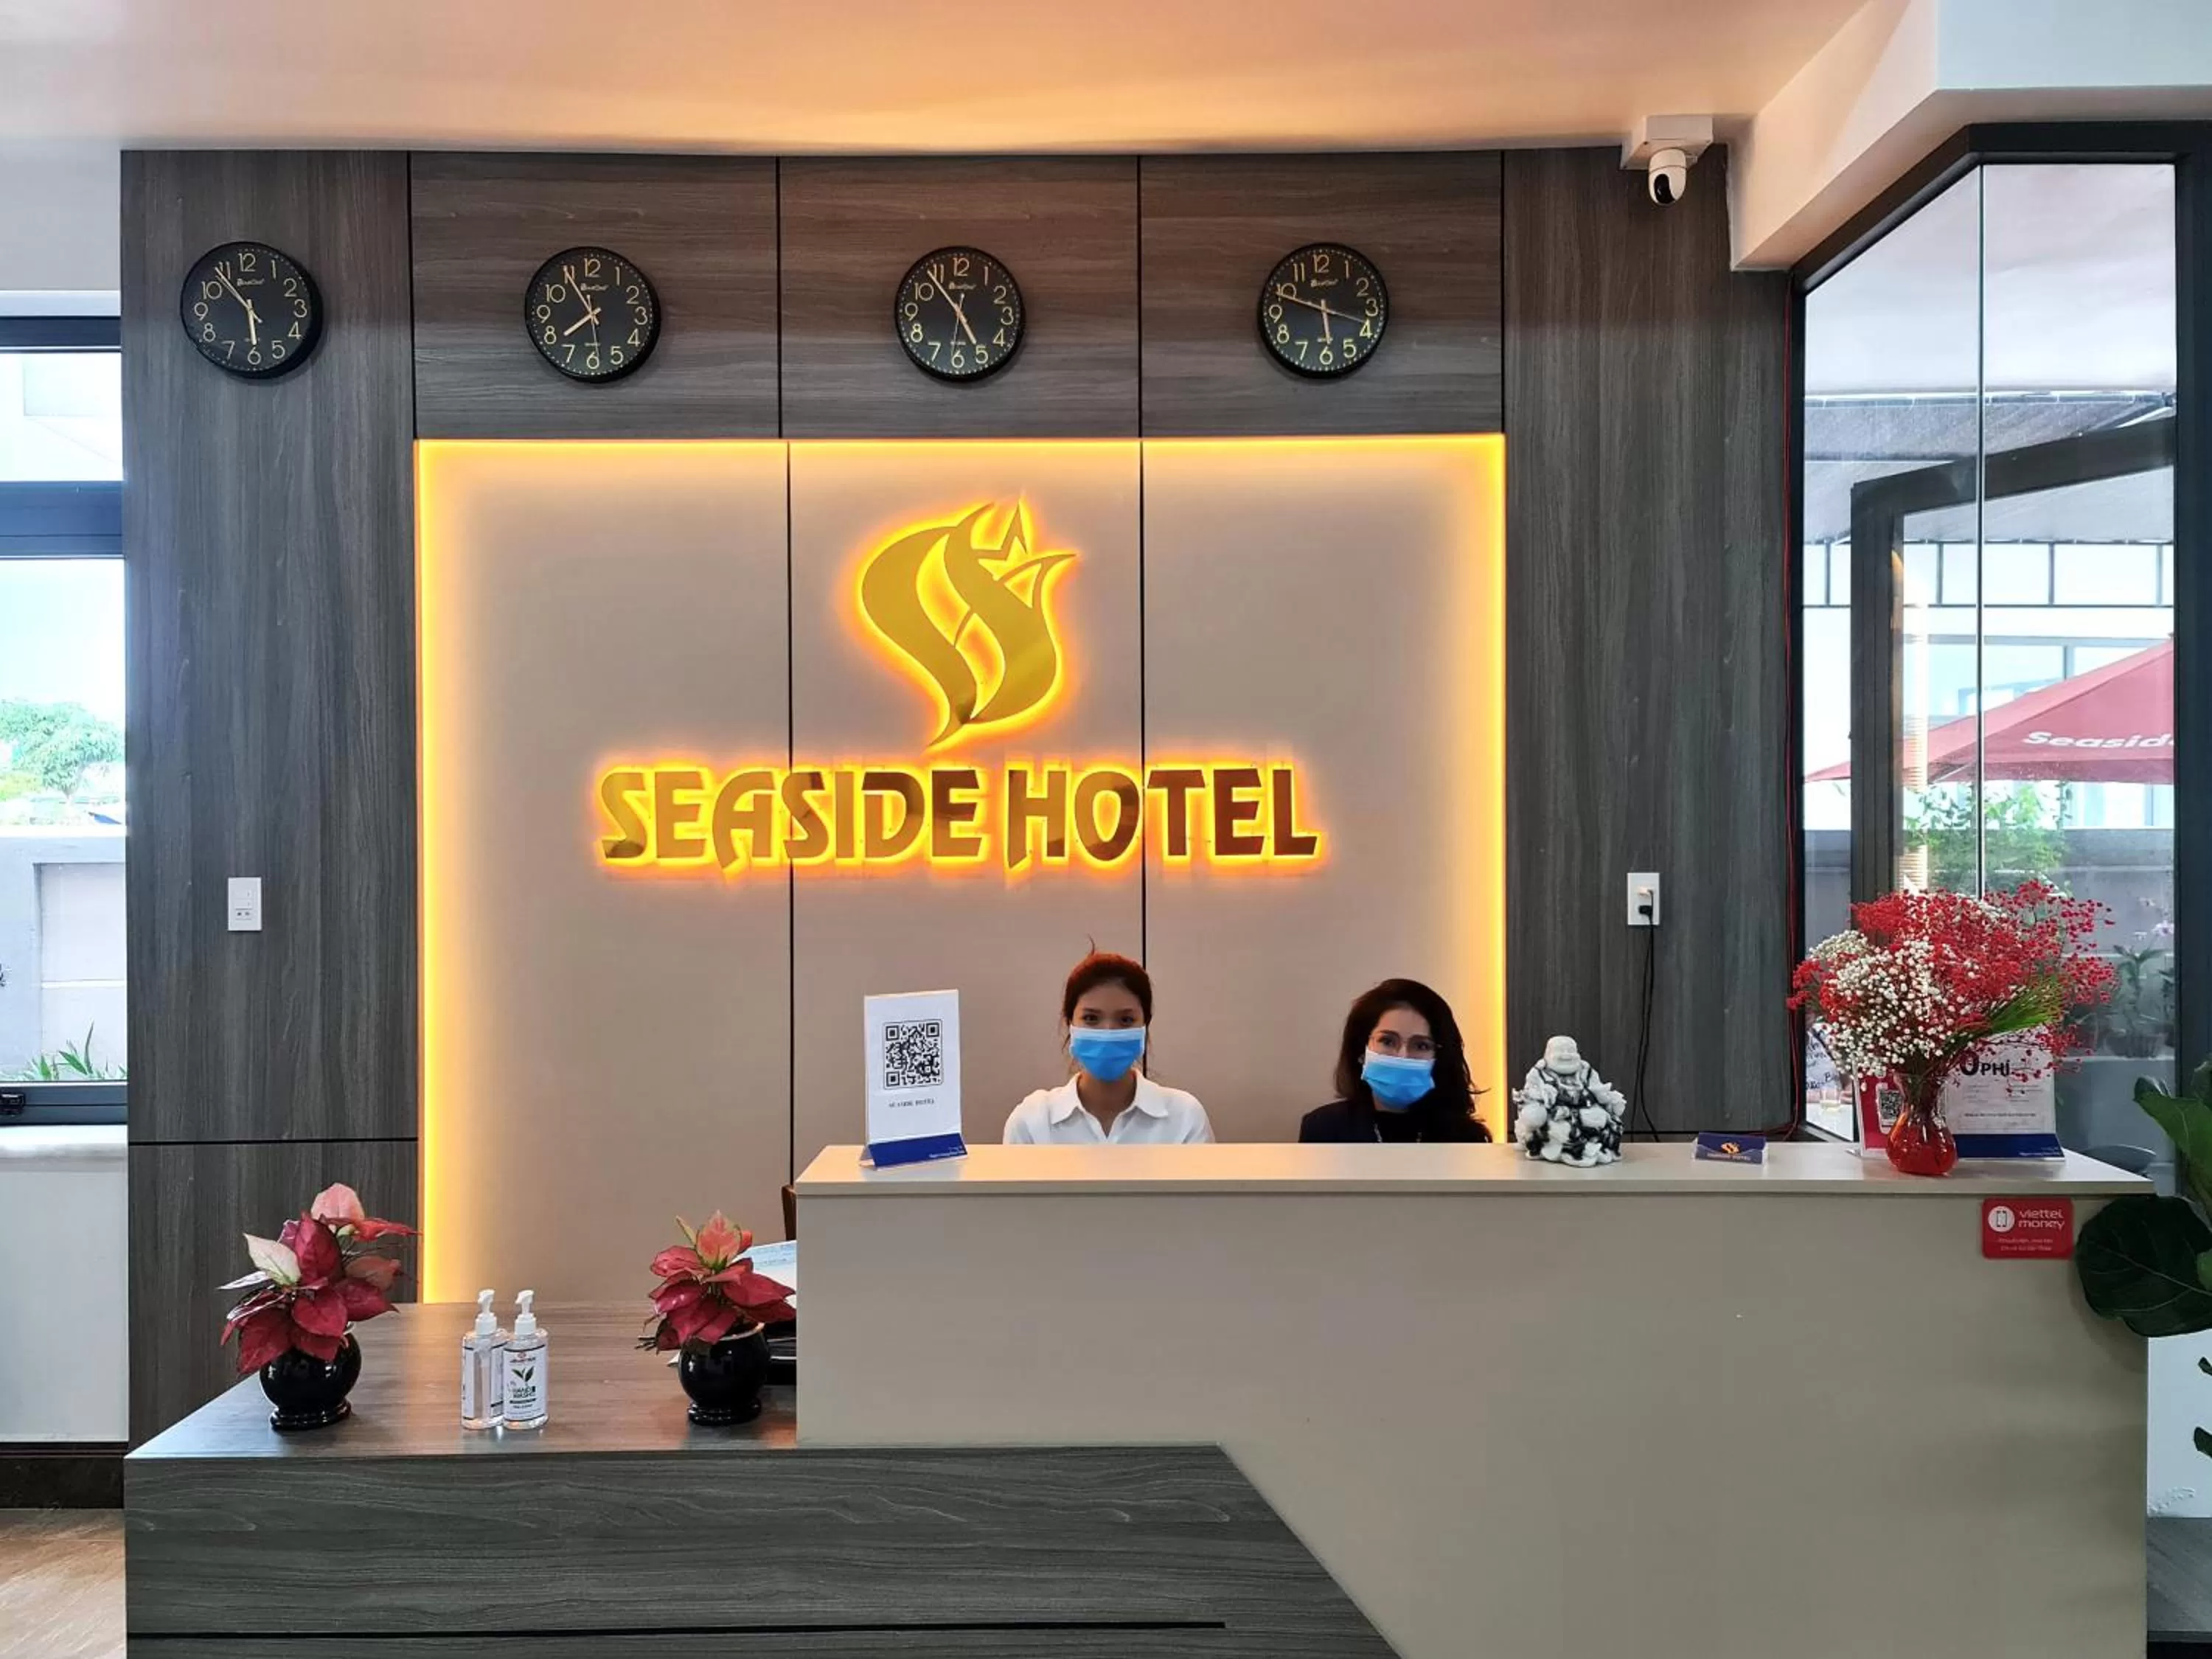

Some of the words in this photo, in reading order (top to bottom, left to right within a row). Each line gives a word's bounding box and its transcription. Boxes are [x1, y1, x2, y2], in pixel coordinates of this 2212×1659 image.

[238, 253, 256, 271] 12
[271, 260, 276, 279] 1
[584, 258, 601, 277] 12
[953, 258, 970, 276] 12
[1313, 254, 1329, 273] 12
[1345, 260, 1349, 279] 1
[616, 267, 620, 286] 1
[984, 266, 988, 286] 1
[1293, 262, 1305, 282] 11
[201, 281, 222, 299] 10
[283, 278, 296, 296] 2
[546, 284, 566, 303] 10
[627, 285, 639, 304] 2
[915, 282, 933, 301] 10
[994, 286, 1006, 304] 2
[1357, 278, 1368, 296] 2
[195, 302, 208, 321] 9
[294, 299, 307, 317] 3
[537, 305, 551, 323] 9
[634, 307, 647, 325] 3
[905, 302, 918, 321] 9
[1001, 307, 1013, 325] 3
[1269, 305, 1282, 323] 9
[1366, 299, 1378, 316] 3
[204, 323, 215, 341] 8
[288, 321, 302, 339] 4
[544, 326, 557, 344] 8
[911, 323, 923, 342] 8
[992, 328, 1005, 347] 4
[1277, 324, 1289, 343] 8
[1360, 319, 1372, 338] 4
[627, 329, 640, 347] 4
[222, 341, 235, 359] 7
[248, 347, 261, 364] 6
[272, 341, 285, 359] 5
[562, 344, 575, 363] 7
[611, 346, 624, 364] 5
[928, 342, 941, 361] 7
[975, 345, 988, 364] 5
[1295, 341, 1308, 360] 7
[1320, 347, 1333, 364] 6
[1343, 339, 1357, 358] 5
[587, 352, 599, 369] 6
[952, 350, 964, 368] 6
[2023, 731, 2174, 748] Seasid
[601, 769, 982, 869] SEASIDE
[1008, 768, 1318, 869] HOTEL
[2020, 1209, 2064, 1219] viettel
[2018, 1220, 2065, 1230] money
